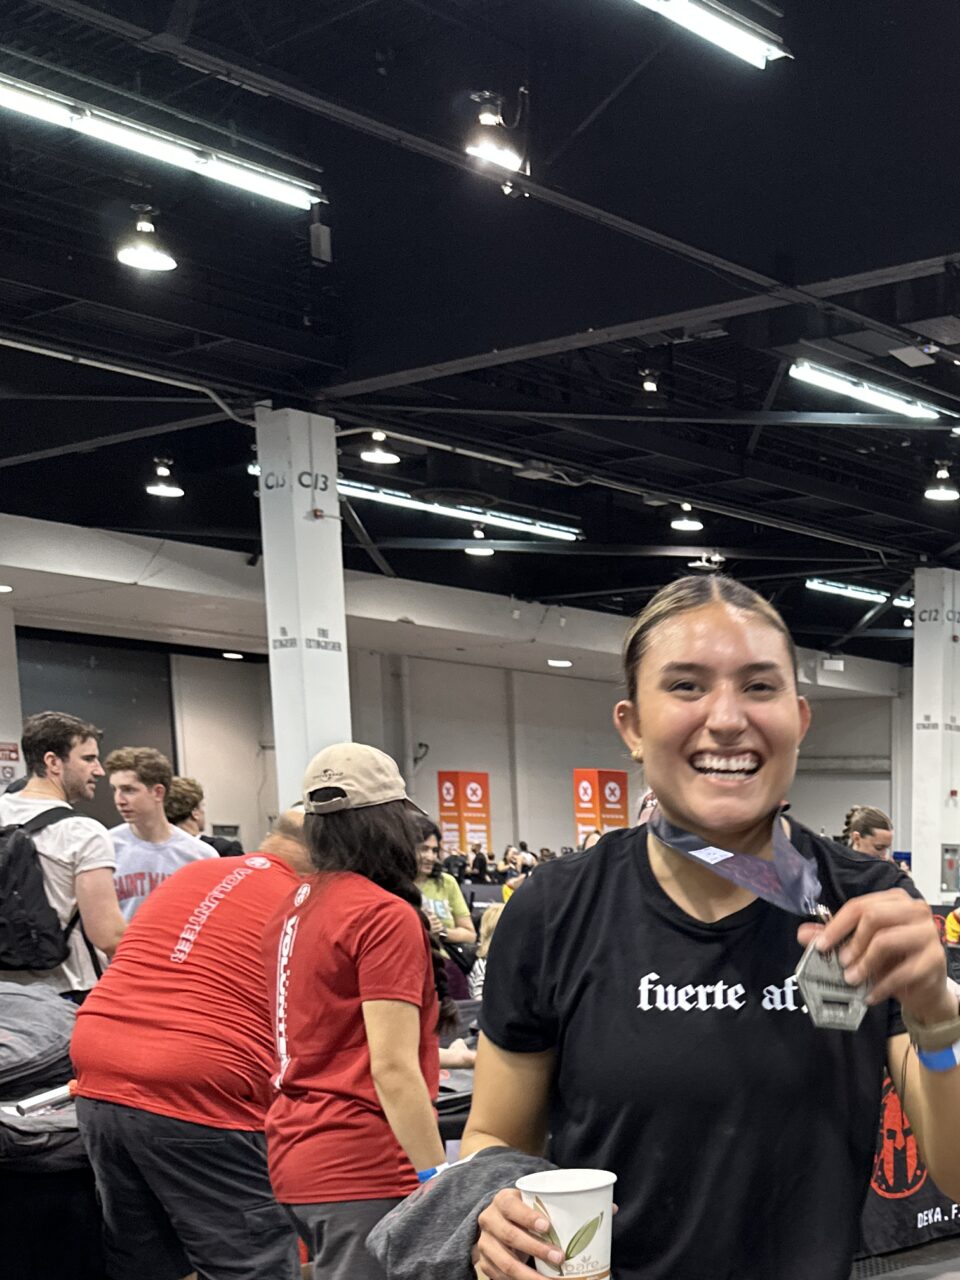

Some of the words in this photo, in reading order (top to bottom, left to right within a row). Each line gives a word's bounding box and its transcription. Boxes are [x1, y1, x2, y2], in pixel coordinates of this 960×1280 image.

[298, 471, 329, 491] C13
[918, 609, 940, 623] C12
[170, 867, 252, 964] VOLUNTEER
[636, 971, 747, 1011] fuerte
[761, 974, 809, 1014] af.
